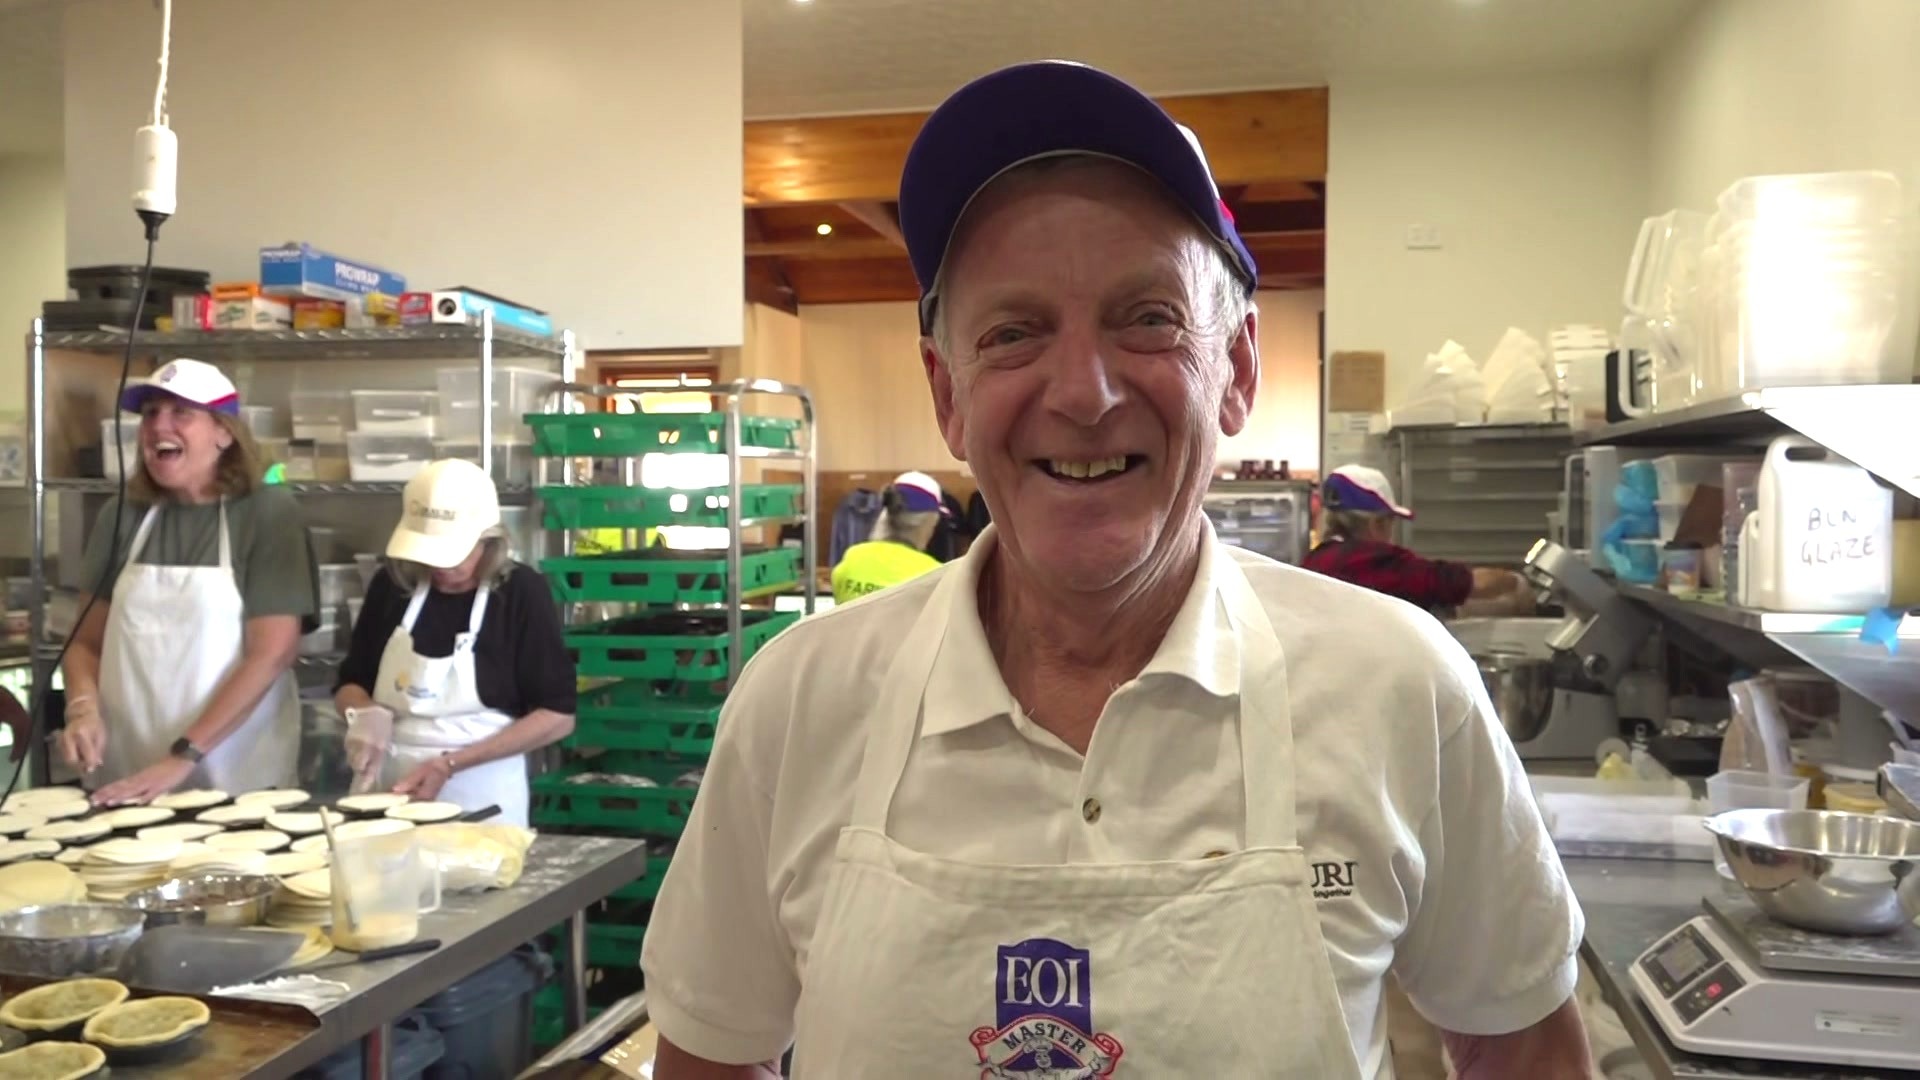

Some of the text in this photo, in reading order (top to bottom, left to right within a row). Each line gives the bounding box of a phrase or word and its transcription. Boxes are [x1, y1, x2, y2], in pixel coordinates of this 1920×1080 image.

[334, 261, 380, 286] PROWRAP
[1801, 535, 1875, 566] GLAZE
[1003, 955, 1084, 1007] EOI
[1003, 1023, 1086, 1055] MASTER
